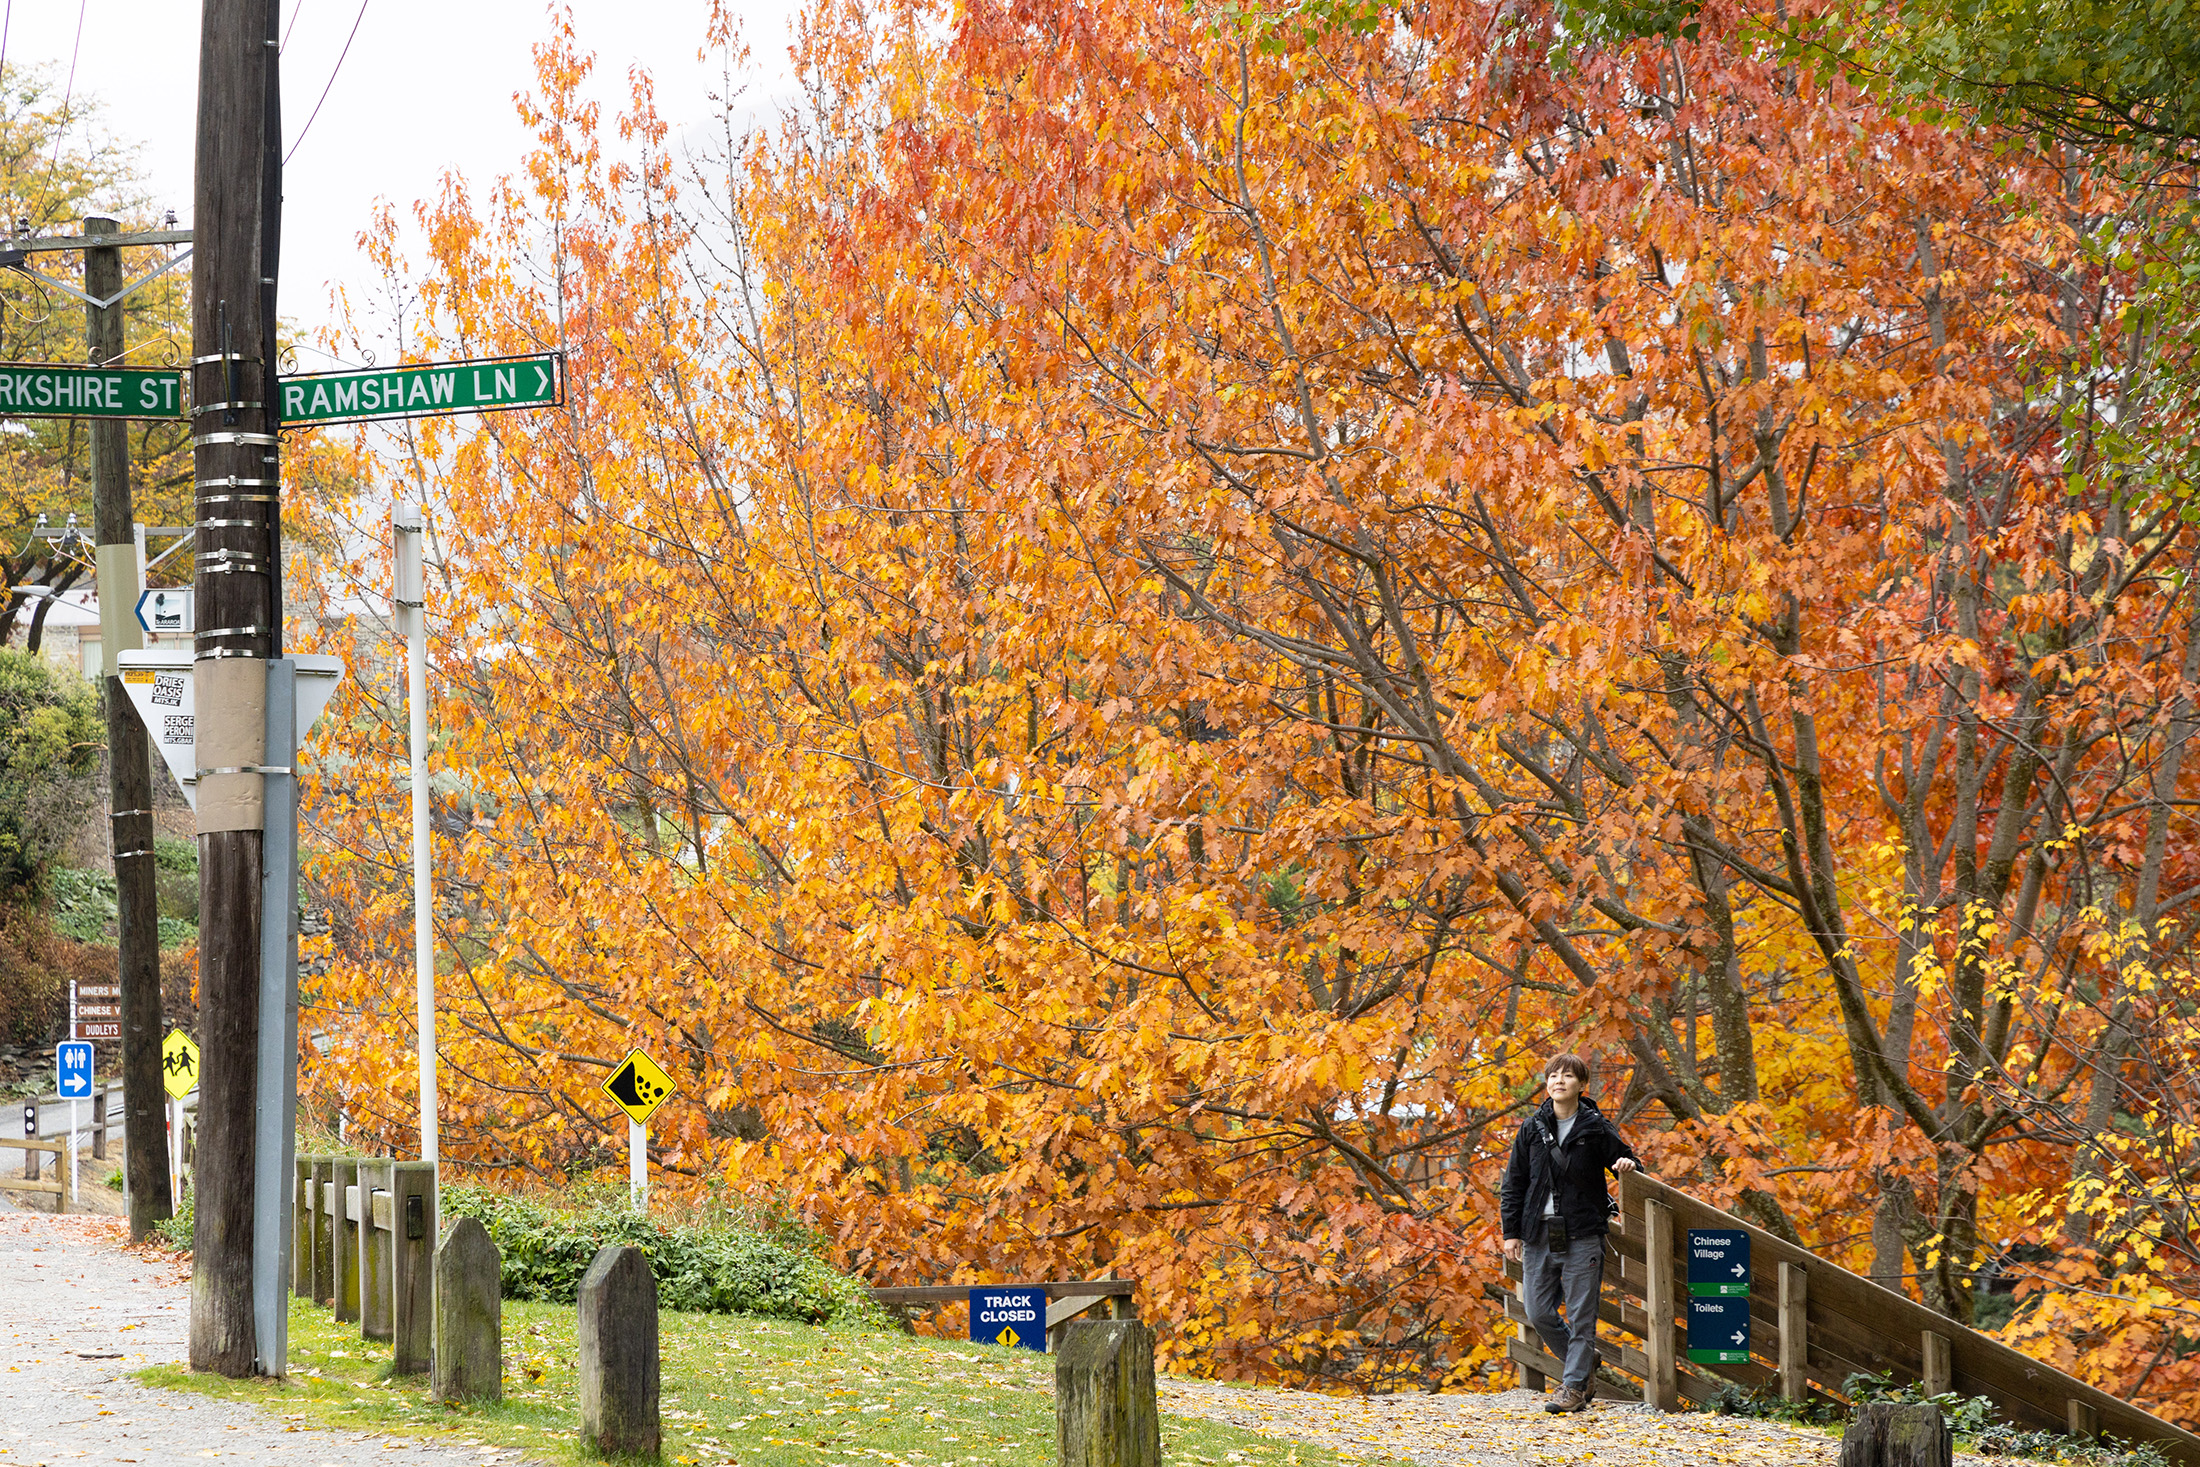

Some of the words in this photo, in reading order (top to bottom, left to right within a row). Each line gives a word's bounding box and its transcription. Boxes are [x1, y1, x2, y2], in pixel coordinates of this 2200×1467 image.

[139, 378, 178, 409] ST
[284, 372, 456, 417] RAMSHAW
[473, 367, 517, 401] LN
[155, 676, 184, 688] DRIES
[153, 685, 182, 698] OASIS
[164, 716, 194, 726] SERGE
[164, 726, 193, 736] PERONI
[79, 986, 109, 996] MINERS
[78, 1005, 111, 1015] CHINESE
[1693, 1236, 1731, 1246] Chinese
[1693, 1249, 1725, 1260] Village
[984, 1295, 1032, 1308] TRACK
[1693, 1303, 1724, 1313] Toilets
[980, 1310, 1036, 1323] CLOSED
